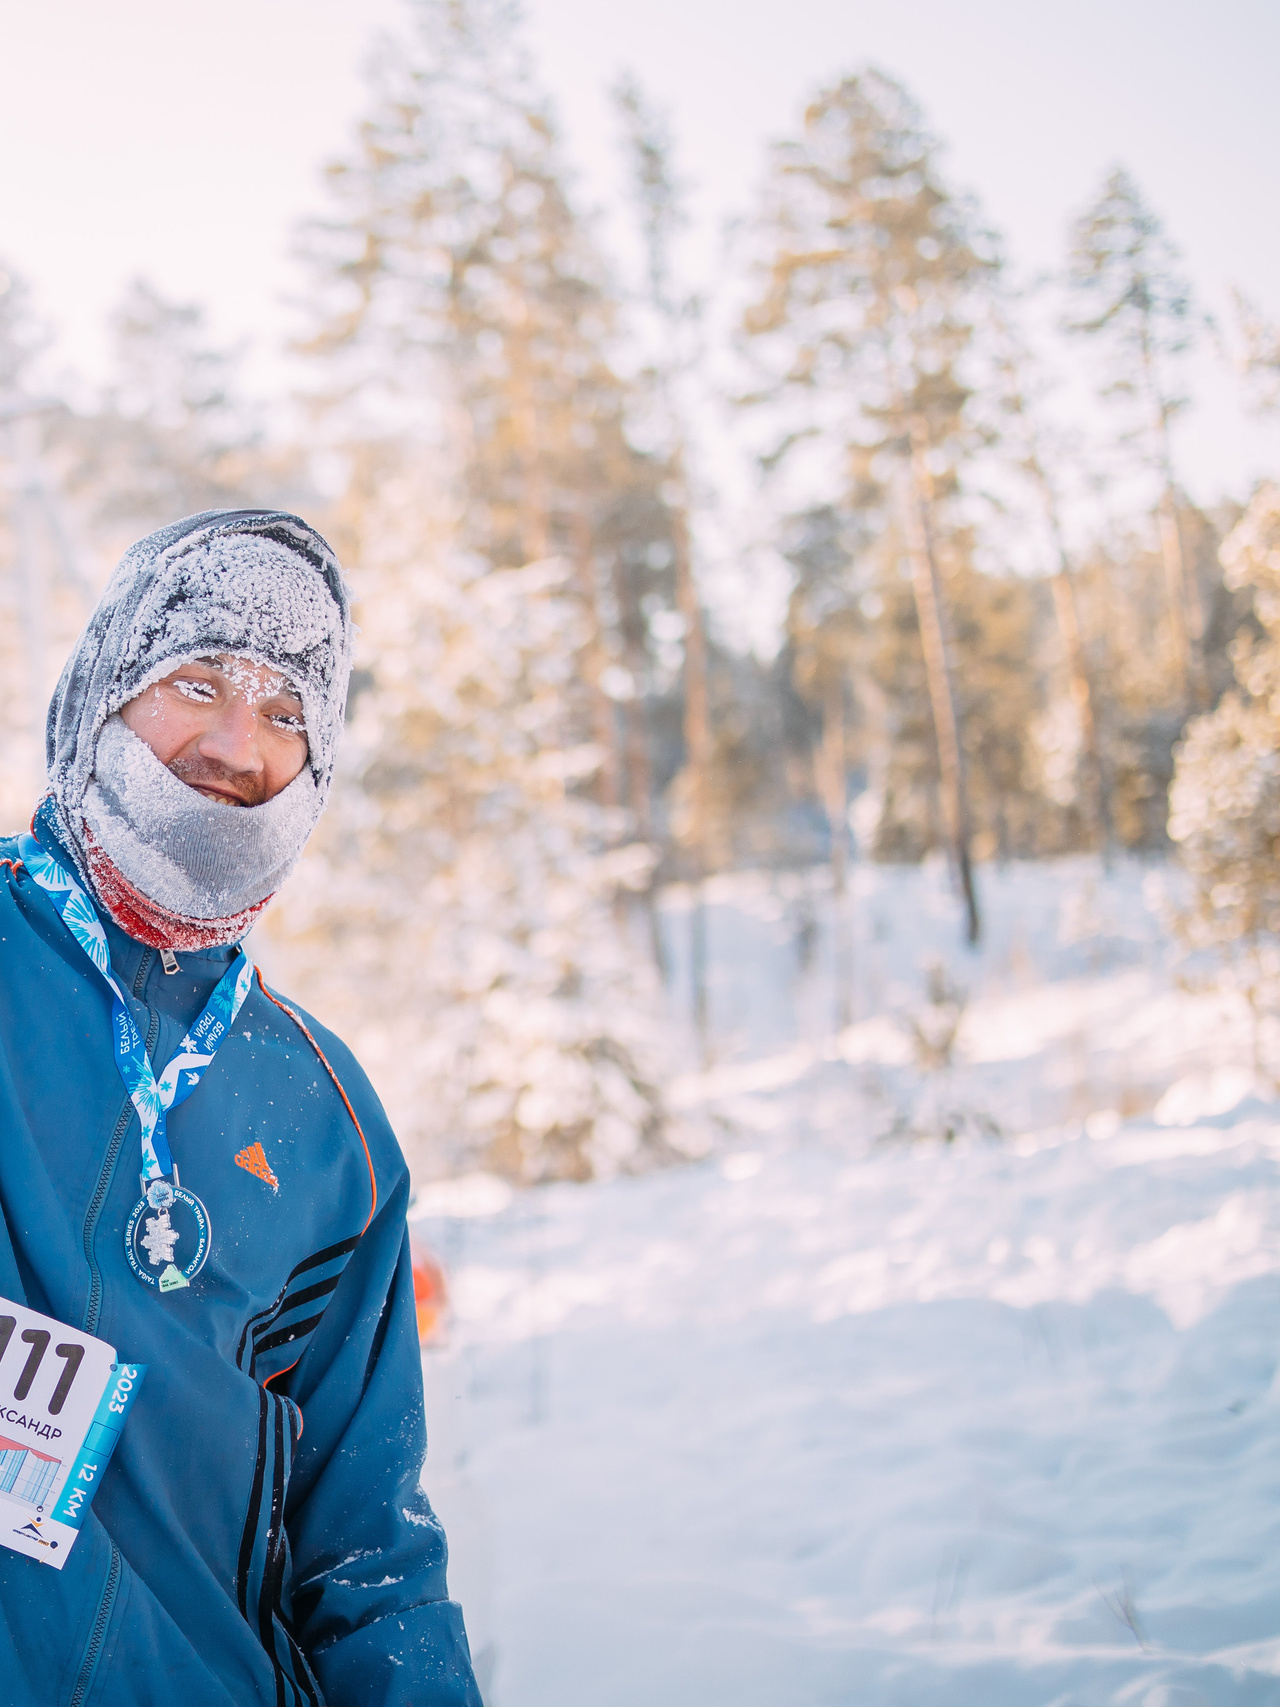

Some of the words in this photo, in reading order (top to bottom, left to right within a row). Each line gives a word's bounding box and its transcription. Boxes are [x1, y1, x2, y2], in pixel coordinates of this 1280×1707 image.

[116, 1010, 130, 1055] БЕЛЫЙ
[193, 1011, 216, 1038] ТРЕЙЛ
[203, 1020, 225, 1052] БЕЛЫЙ
[131, 1200, 146, 1218] 2023
[125, 1219, 135, 1247] SERIES
[127, 1249, 139, 1270] TRAIL
[138, 1269, 155, 1285] TAIGA
[108, 1365, 138, 1415] 2023
[78, 1462, 98, 1482] 12
[62, 1487, 87, 1518] KM
